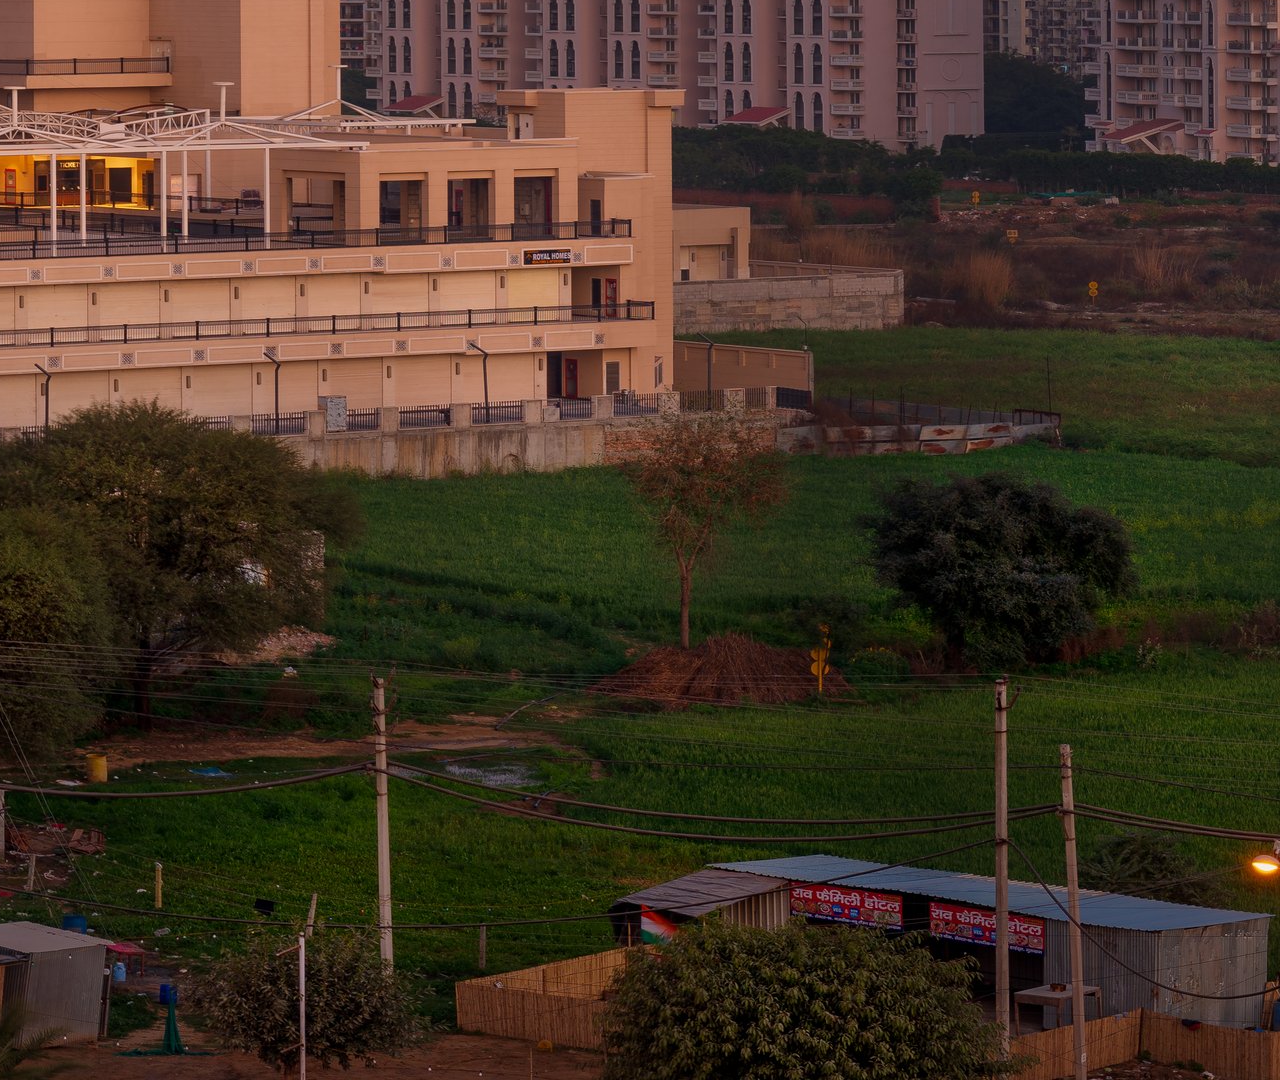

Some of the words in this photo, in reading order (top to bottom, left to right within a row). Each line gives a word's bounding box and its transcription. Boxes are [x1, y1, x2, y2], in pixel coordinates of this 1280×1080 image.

[59, 161, 81, 169] TICKET
[552, 252, 571, 260] HOMES
[816, 888, 861, 907] फैमिली
[863, 894, 901, 912] होटल
